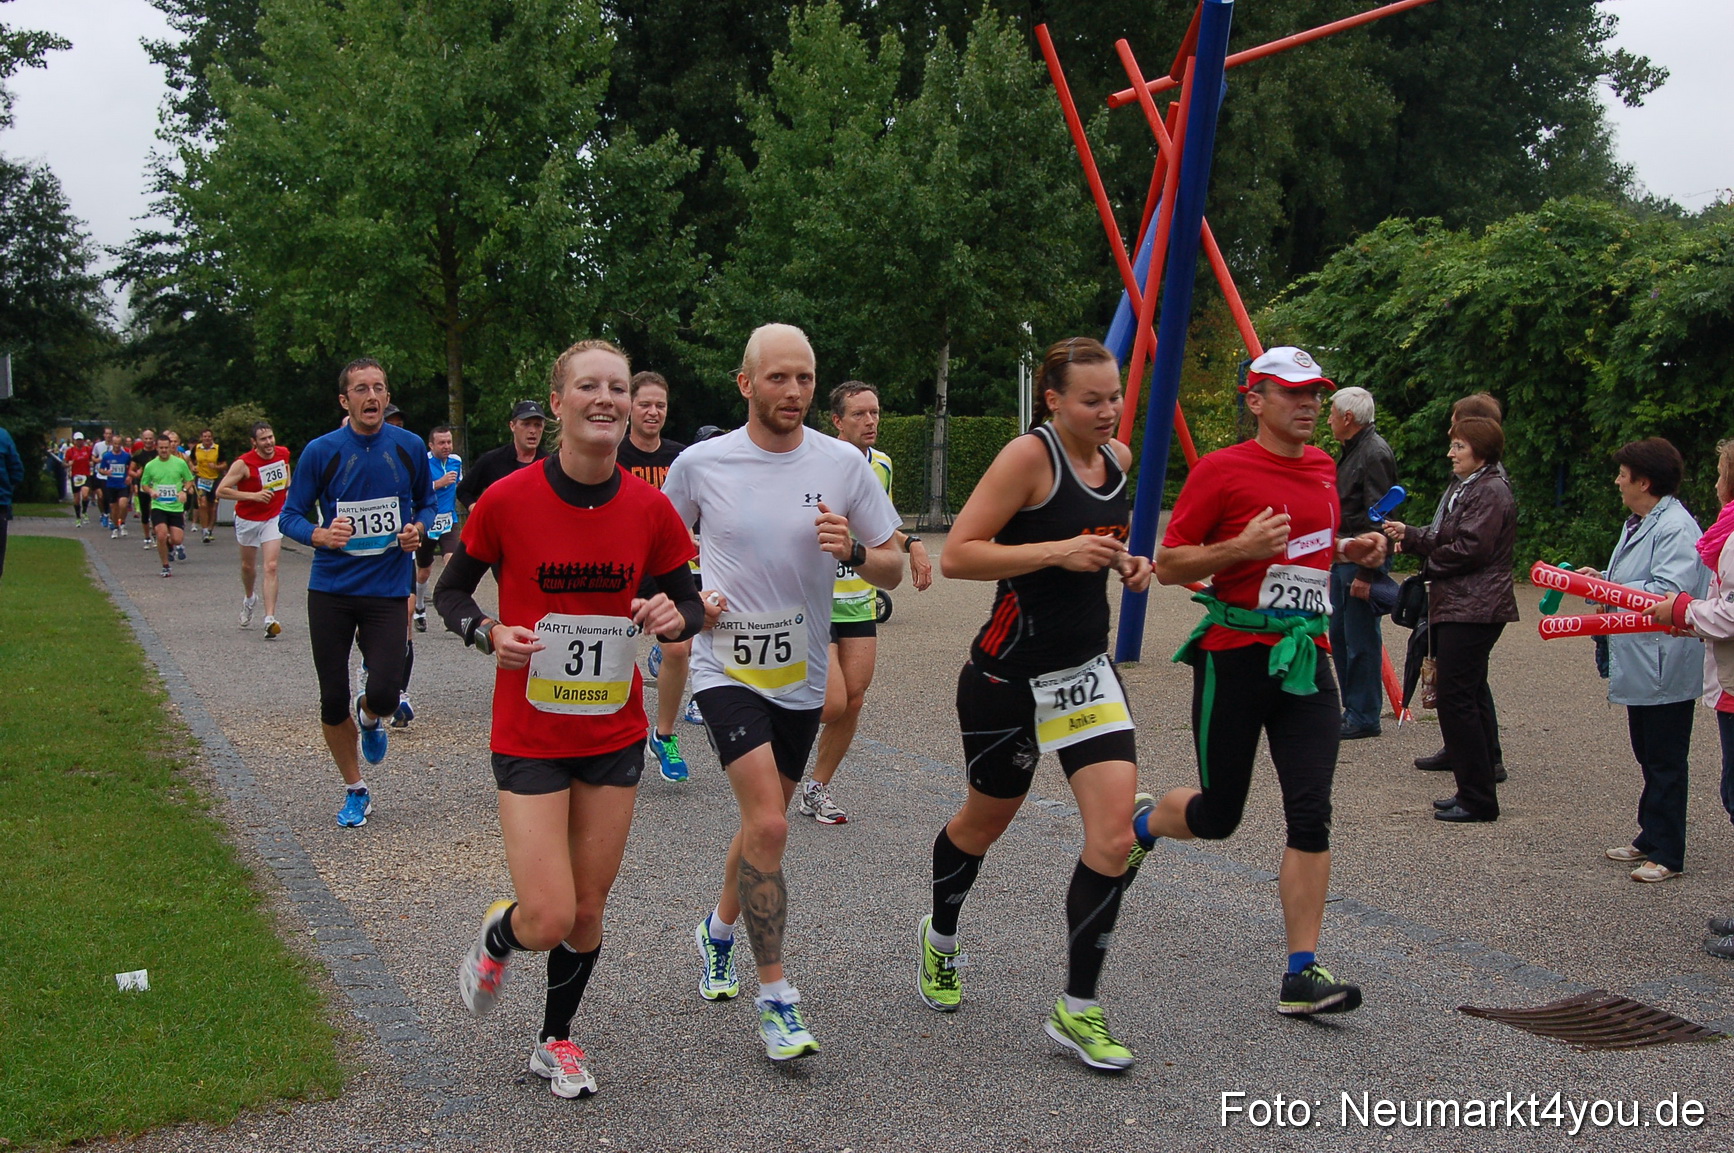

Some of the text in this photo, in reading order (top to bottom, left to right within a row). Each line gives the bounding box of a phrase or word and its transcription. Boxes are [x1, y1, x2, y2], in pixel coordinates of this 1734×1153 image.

[266, 469, 283, 483] 236
[159, 489, 176, 497] 2913
[360, 504, 389, 512] Neumarkt
[543, 579, 564, 589] RUN
[567, 577, 588, 589] FOR
[1586, 582, 1622, 603] BKK
[714, 619, 793, 630] PARTL Neumarkt
[1600, 615, 1635, 628] BKK
[537, 622, 623, 636] PARTL Neumarkt
[733, 631, 792, 665] 575
[564, 640, 604, 677] 31
[553, 685, 609, 701] Vanessa
[1053, 672, 1105, 711] 462
[1069, 713, 1096, 731] Anke
